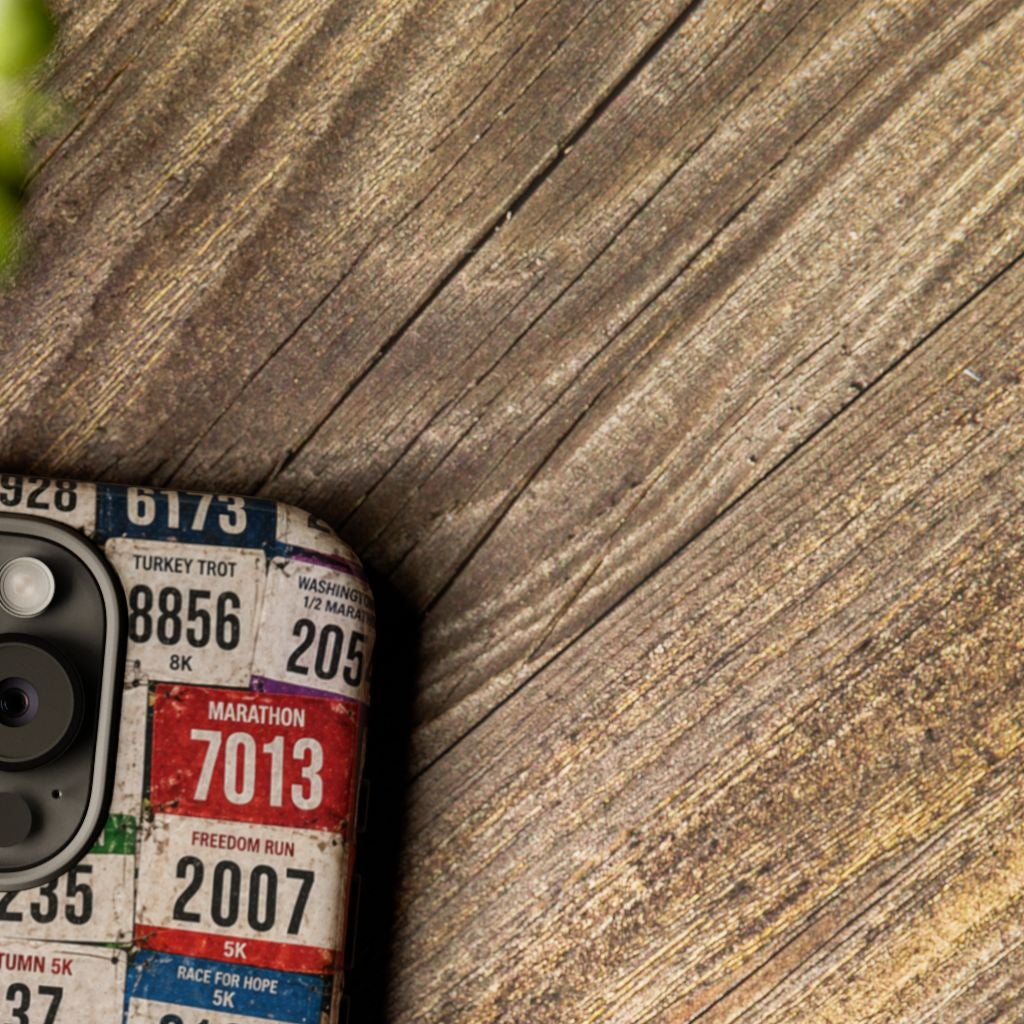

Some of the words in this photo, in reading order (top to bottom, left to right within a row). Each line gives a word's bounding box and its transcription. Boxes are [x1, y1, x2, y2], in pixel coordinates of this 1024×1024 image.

[127, 487, 247, 535] 6173
[133, 555, 193, 574] TURKEY
[198, 560, 236, 577] TROT
[298, 576, 373, 608] WASHINGTO
[304, 596, 322, 611] 1/2
[128, 585, 241, 651] 8856
[169, 654, 192, 671] 8K
[287, 619, 370, 687] 205
[208, 701, 305, 727] MARATHON
[190, 729, 324, 811] 7013
[191, 831, 260, 854] FREEDOM
[264, 840, 295, 857] RUN
[173, 856, 315, 936] 2007
[224, 941, 247, 959] 5K
[51, 958, 73, 976] 5K
[177, 966, 211, 984] RACE
[214, 971, 240, 988] FOR
[243, 976, 279, 994] HOPE
[212, 990, 235, 1008] 5K
